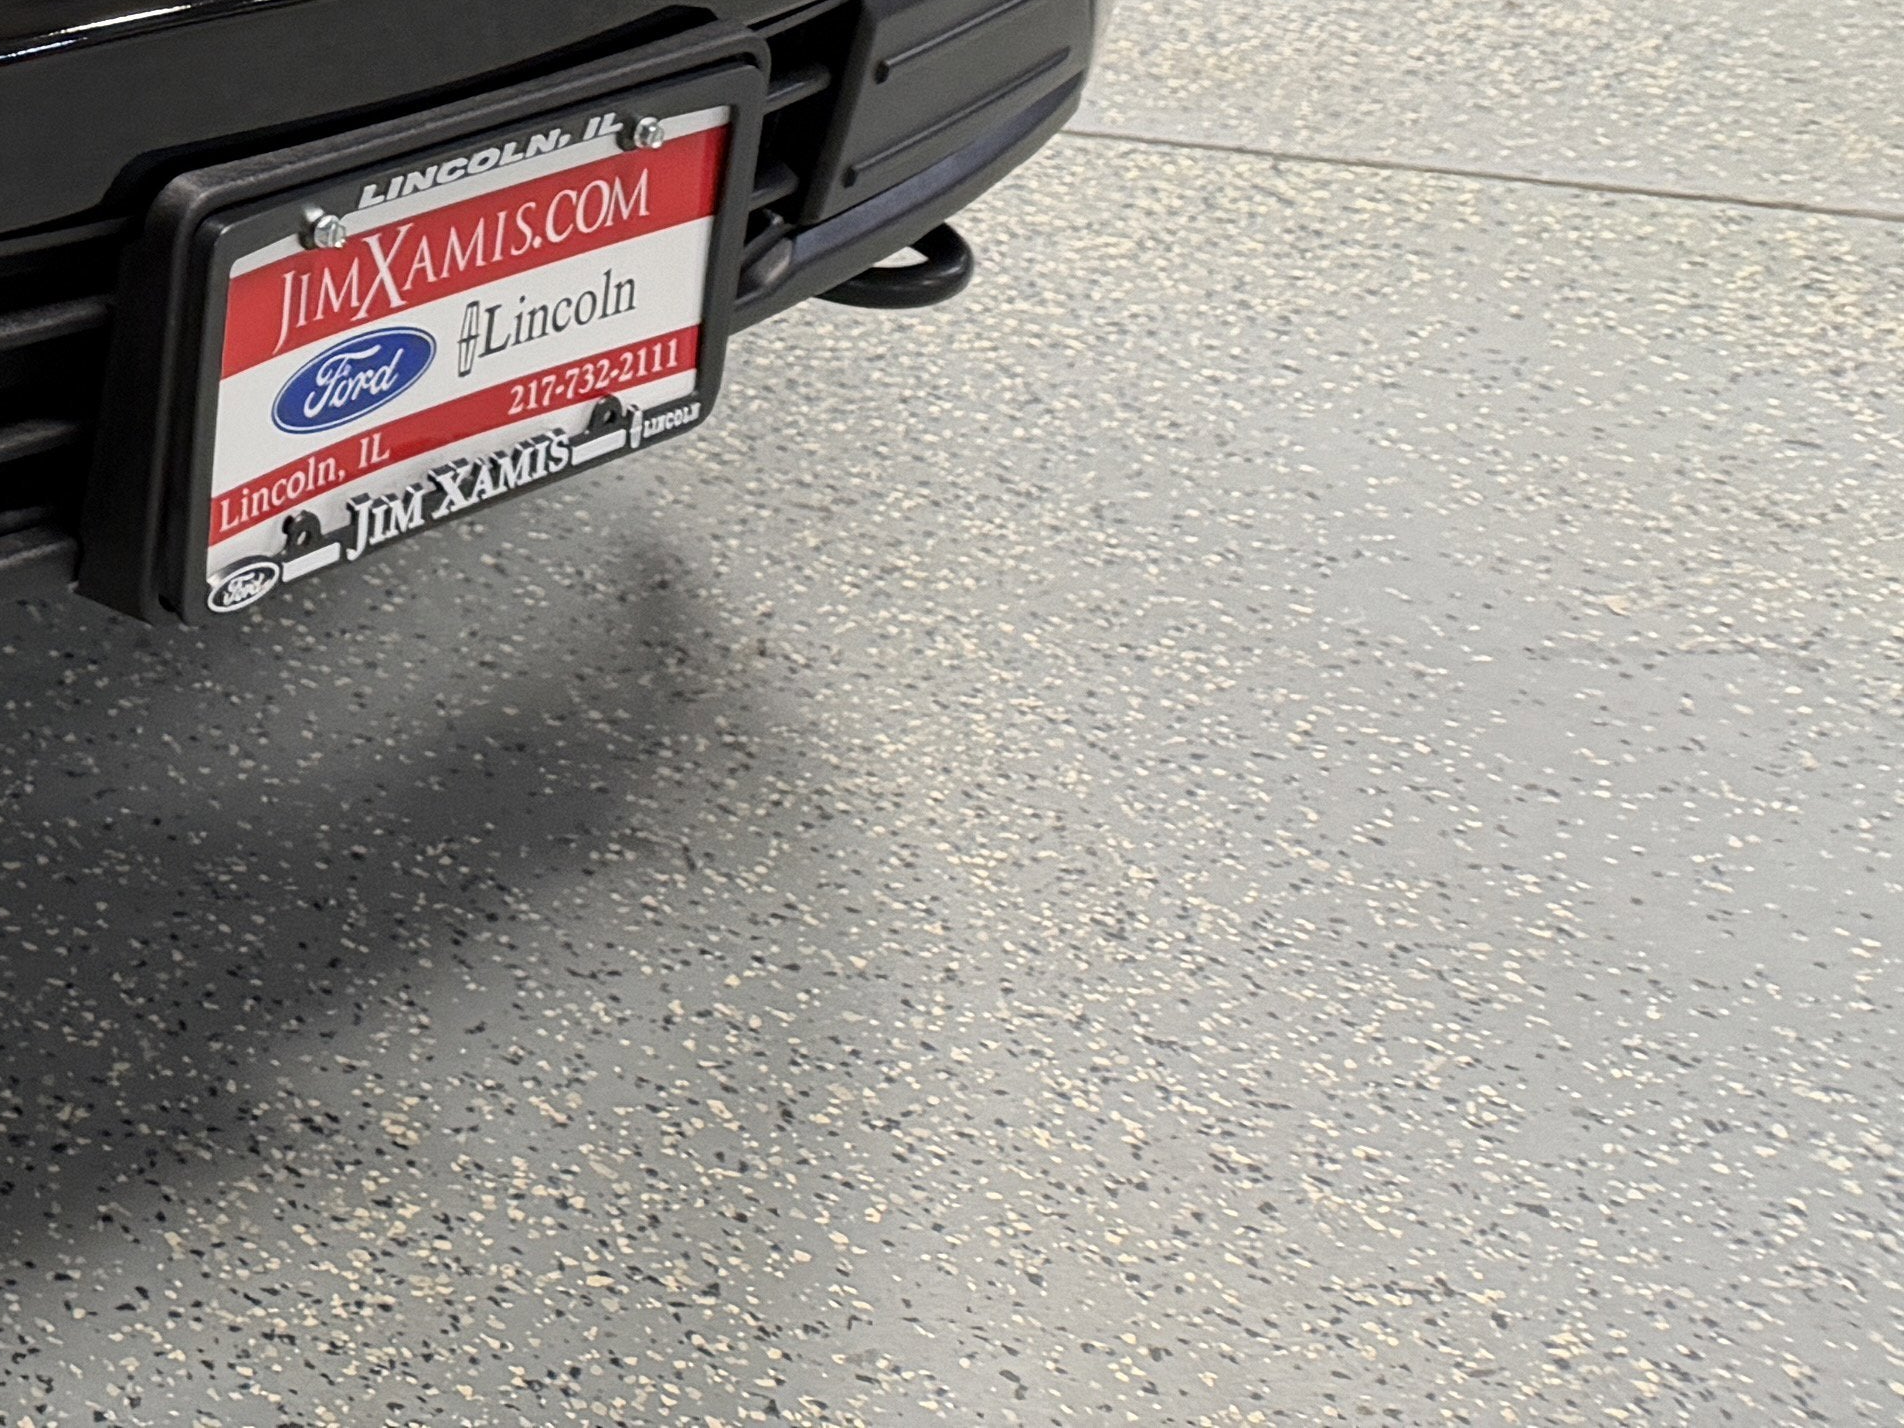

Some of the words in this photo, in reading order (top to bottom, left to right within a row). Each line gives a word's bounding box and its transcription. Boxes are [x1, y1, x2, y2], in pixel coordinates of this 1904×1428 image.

[359, 128, 572, 209] LINCOLN,
[584, 112, 623, 142] IL
[272, 169, 649, 354] JIMXAMIS.COM
[478, 268, 638, 358] Lincoln
[304, 344, 405, 418] Ford
[508, 339, 678, 415] 217-732-2111
[644, 401, 702, 438] LINCOLN
[220, 456, 347, 532] Lincoln,
[360, 436, 390, 469] IL
[347, 491, 425, 561] JIM
[432, 433, 573, 520] XAMIS
[224, 573, 274, 605] Ford
